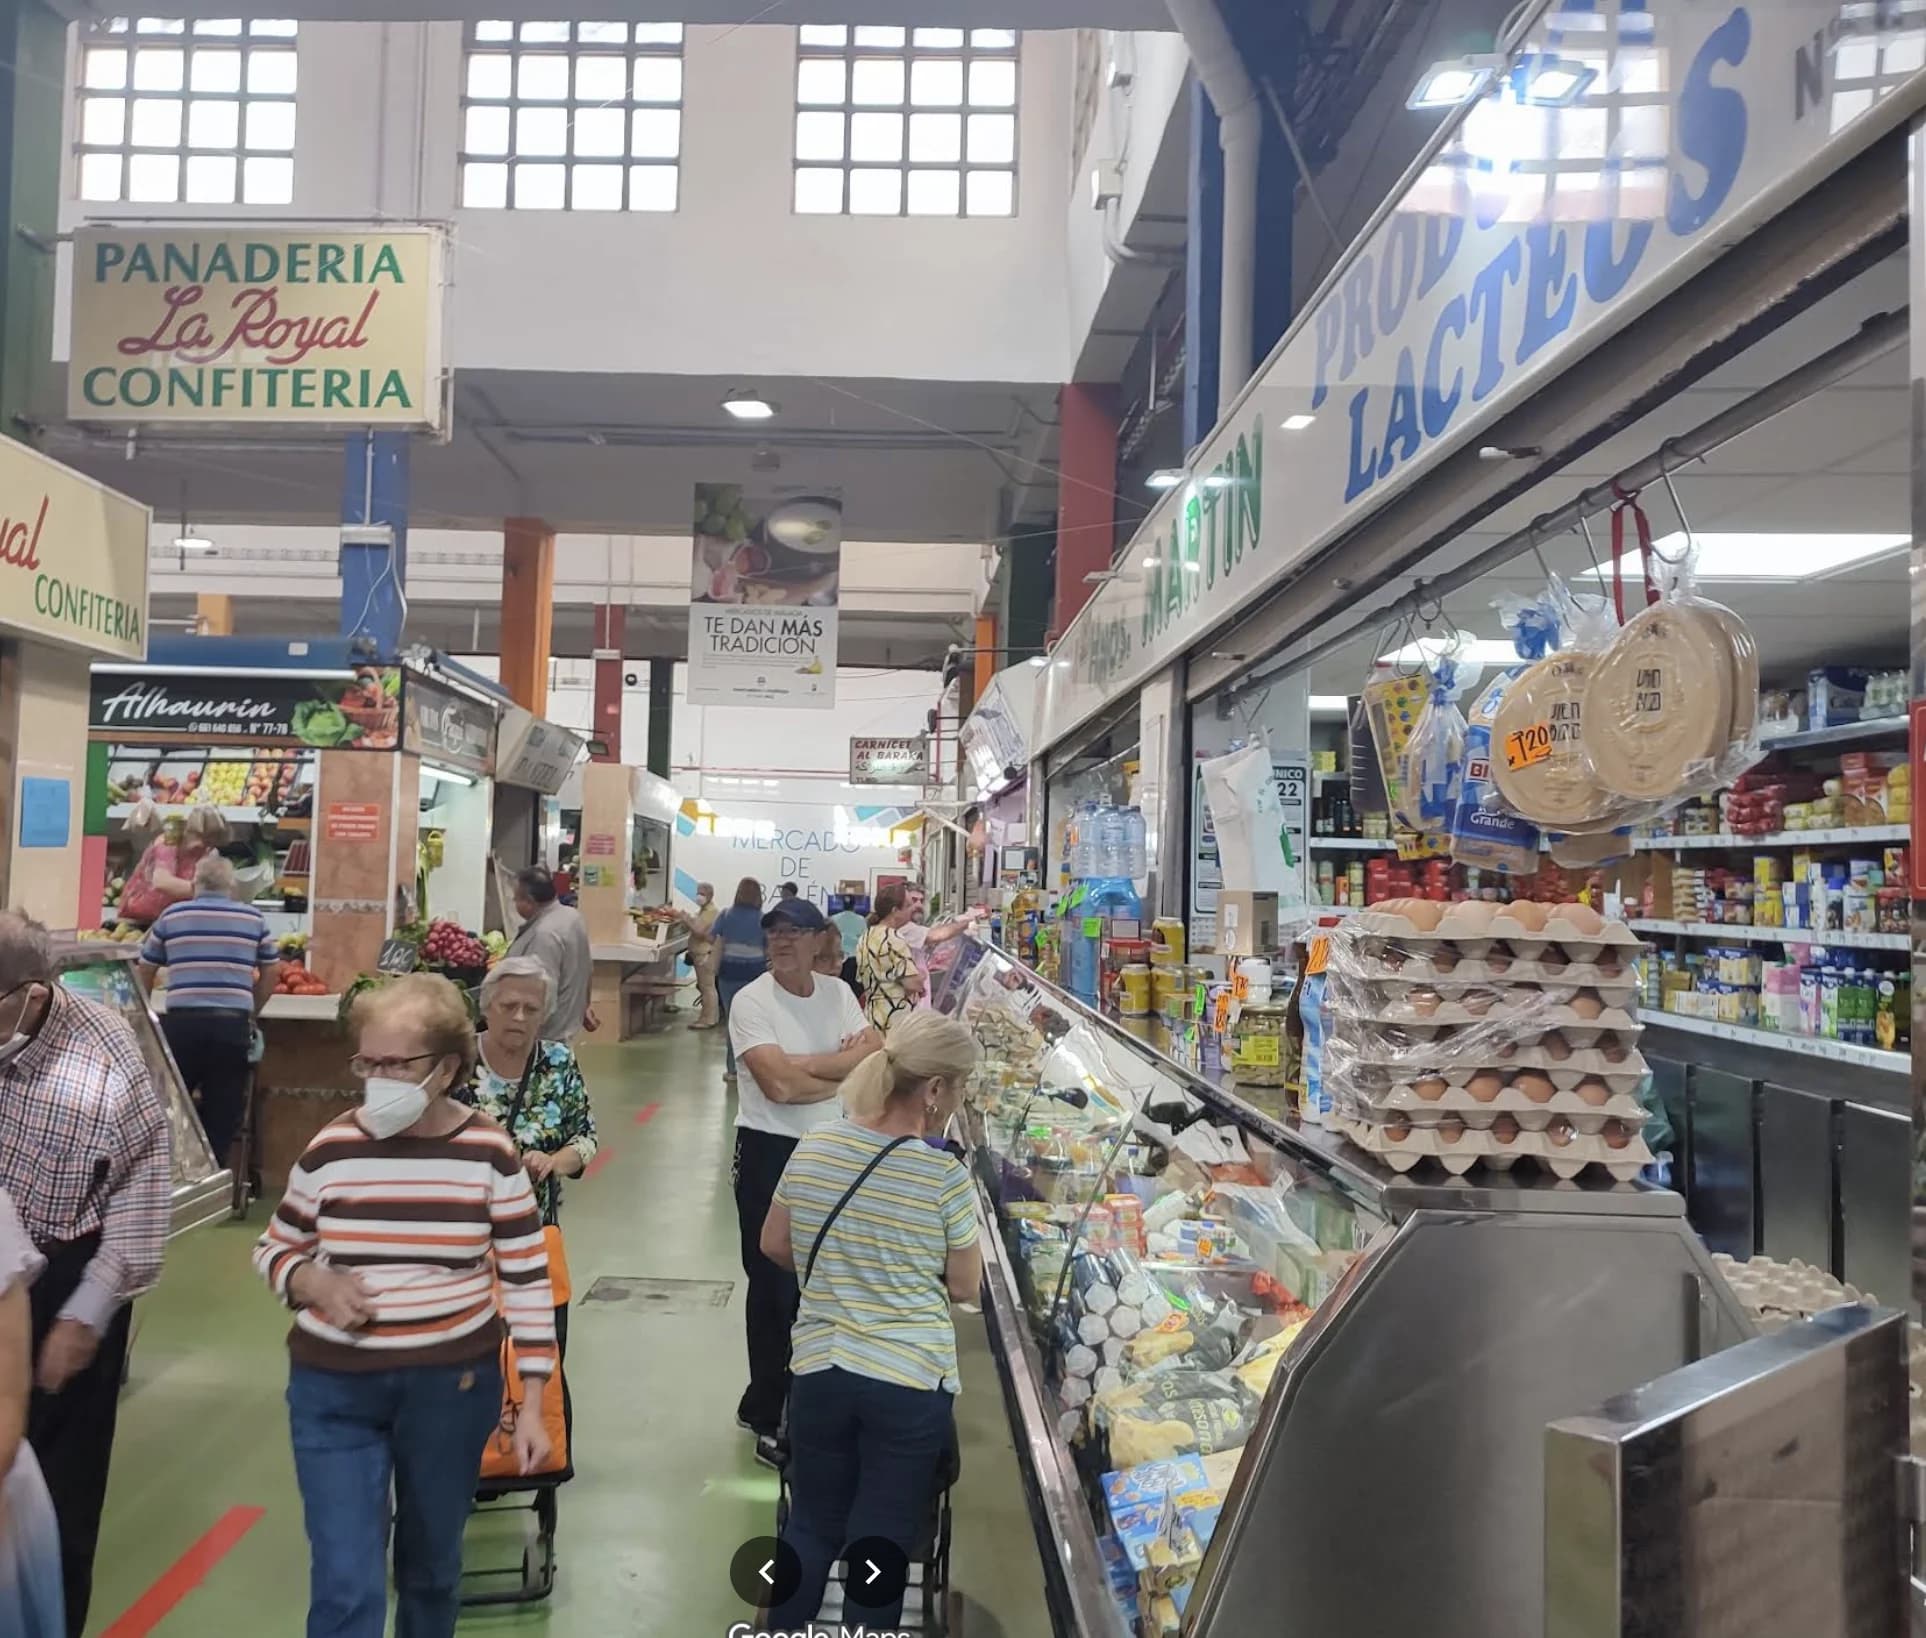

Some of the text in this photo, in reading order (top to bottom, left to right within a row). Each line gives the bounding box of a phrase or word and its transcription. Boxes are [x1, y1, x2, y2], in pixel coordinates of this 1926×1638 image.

[95, 242, 405, 284] PANADERIA
[118, 285, 380, 365] La Royal
[83, 366, 413, 409] CONFITERIA
[34, 573, 140, 646] CONFITERIA
[704, 614, 823, 637] TE DAN MÁS
[710, 634, 816, 655] TRADICIÓN
[1470, 813, 1516, 830] Grande
[780, 856, 811, 878] DE
